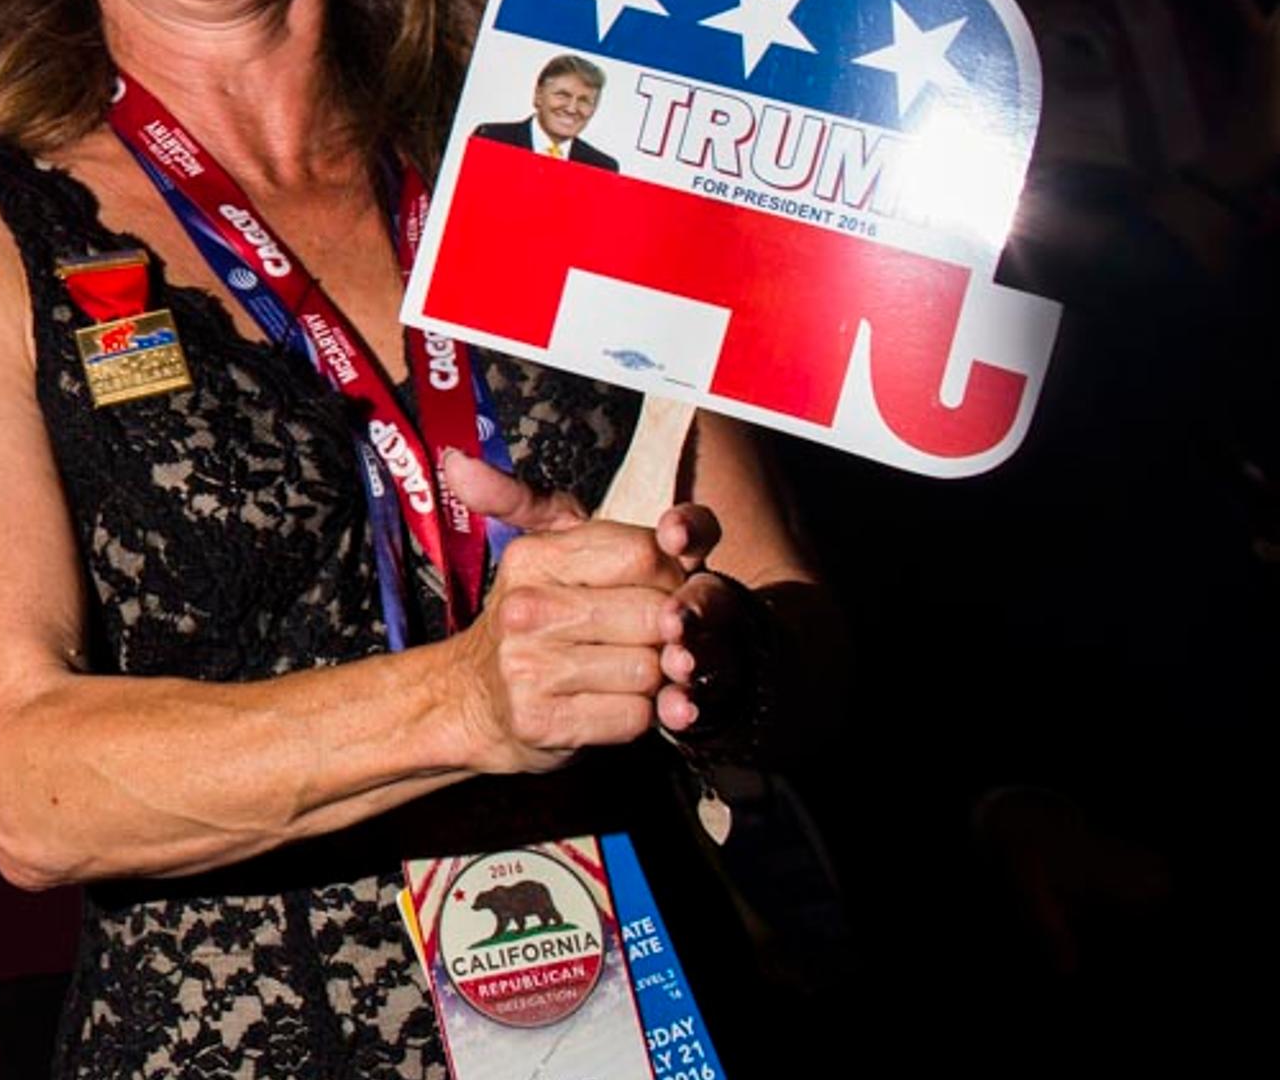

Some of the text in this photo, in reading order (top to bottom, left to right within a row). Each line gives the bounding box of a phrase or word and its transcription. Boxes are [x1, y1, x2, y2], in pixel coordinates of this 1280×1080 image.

[636, 72, 930, 226] TRUM
[692, 175, 877, 237] FOR PRESIDENT 2016
[489, 859, 524, 879] 2016
[451, 931, 601, 977] CALIFORNIA
[477, 966, 585, 998] REPUBLICAN
[496, 989, 578, 1014] DELEGATION
[678, 1040, 706, 1065] 21
